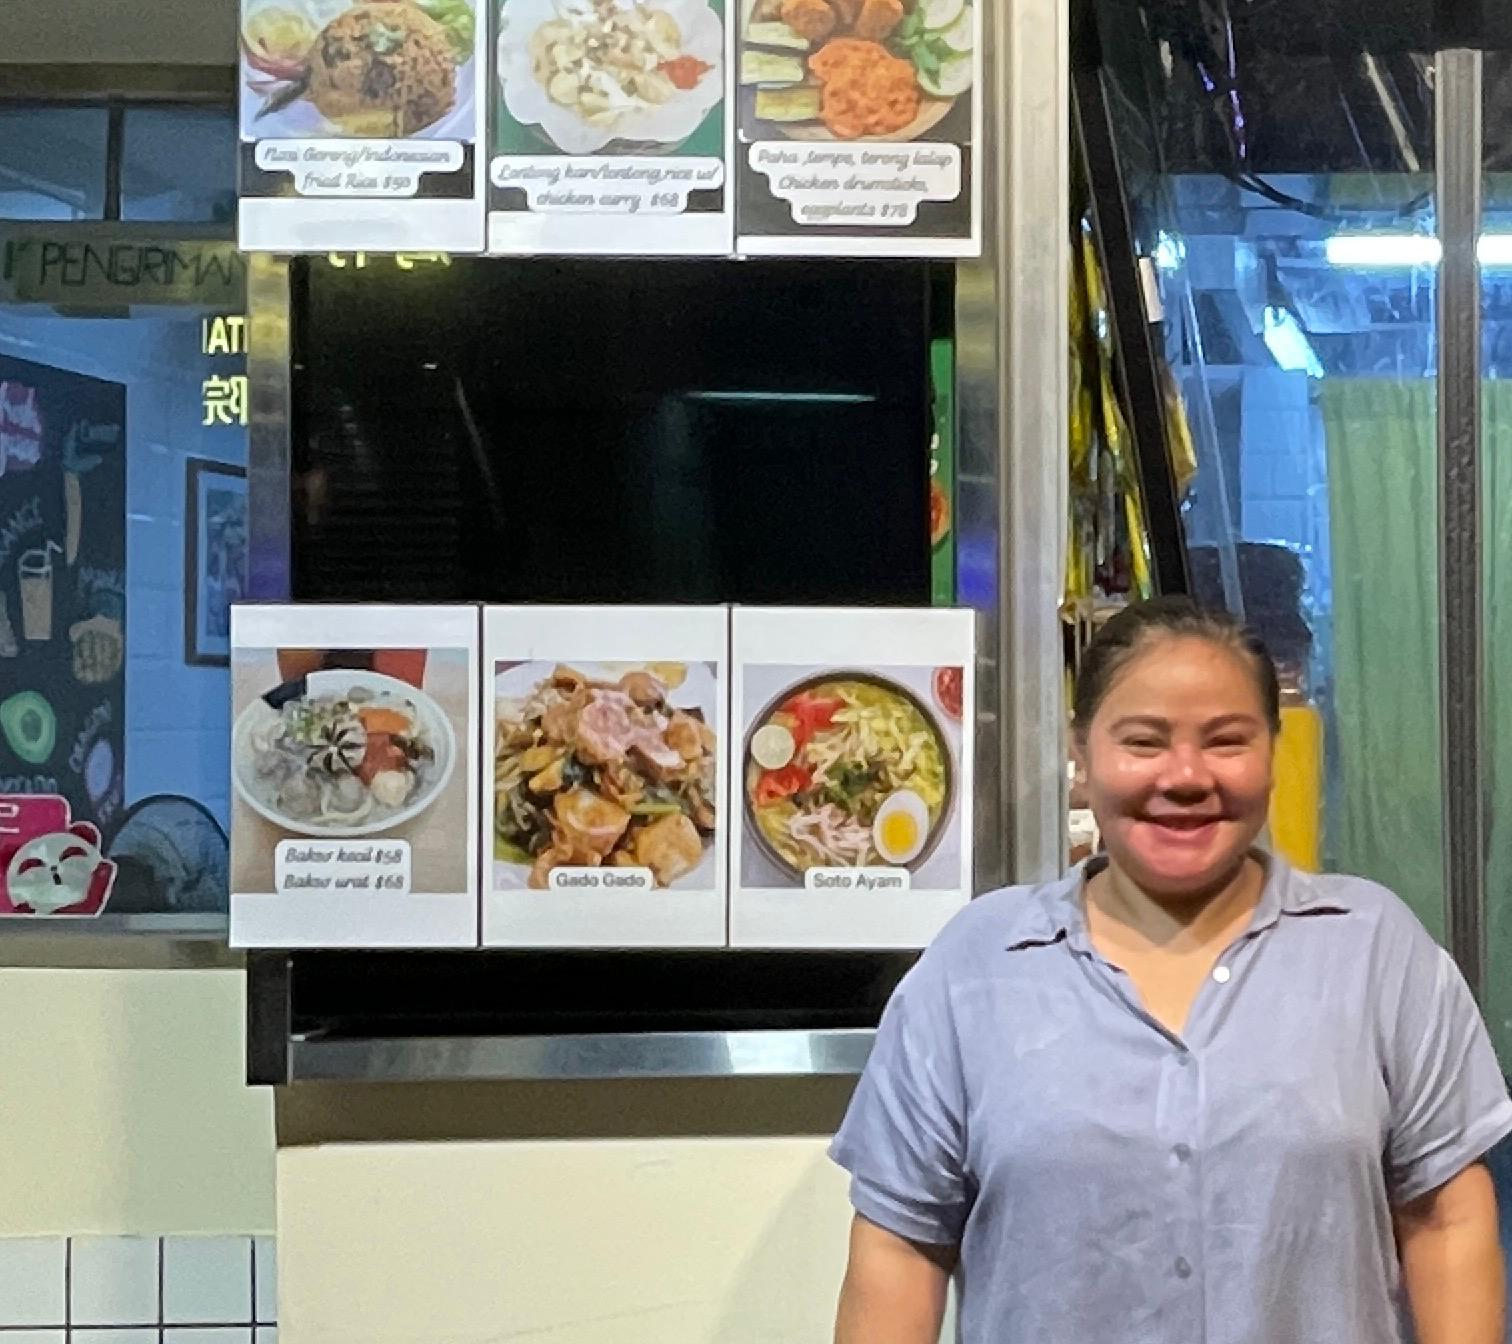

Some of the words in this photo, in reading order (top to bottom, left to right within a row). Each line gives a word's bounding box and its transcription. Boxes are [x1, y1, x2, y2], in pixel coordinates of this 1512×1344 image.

[557, 872, 599, 888] Gado
[602, 872, 646, 888] Gado
[814, 872, 851, 888] Soto
[856, 872, 902, 891] Ayam
